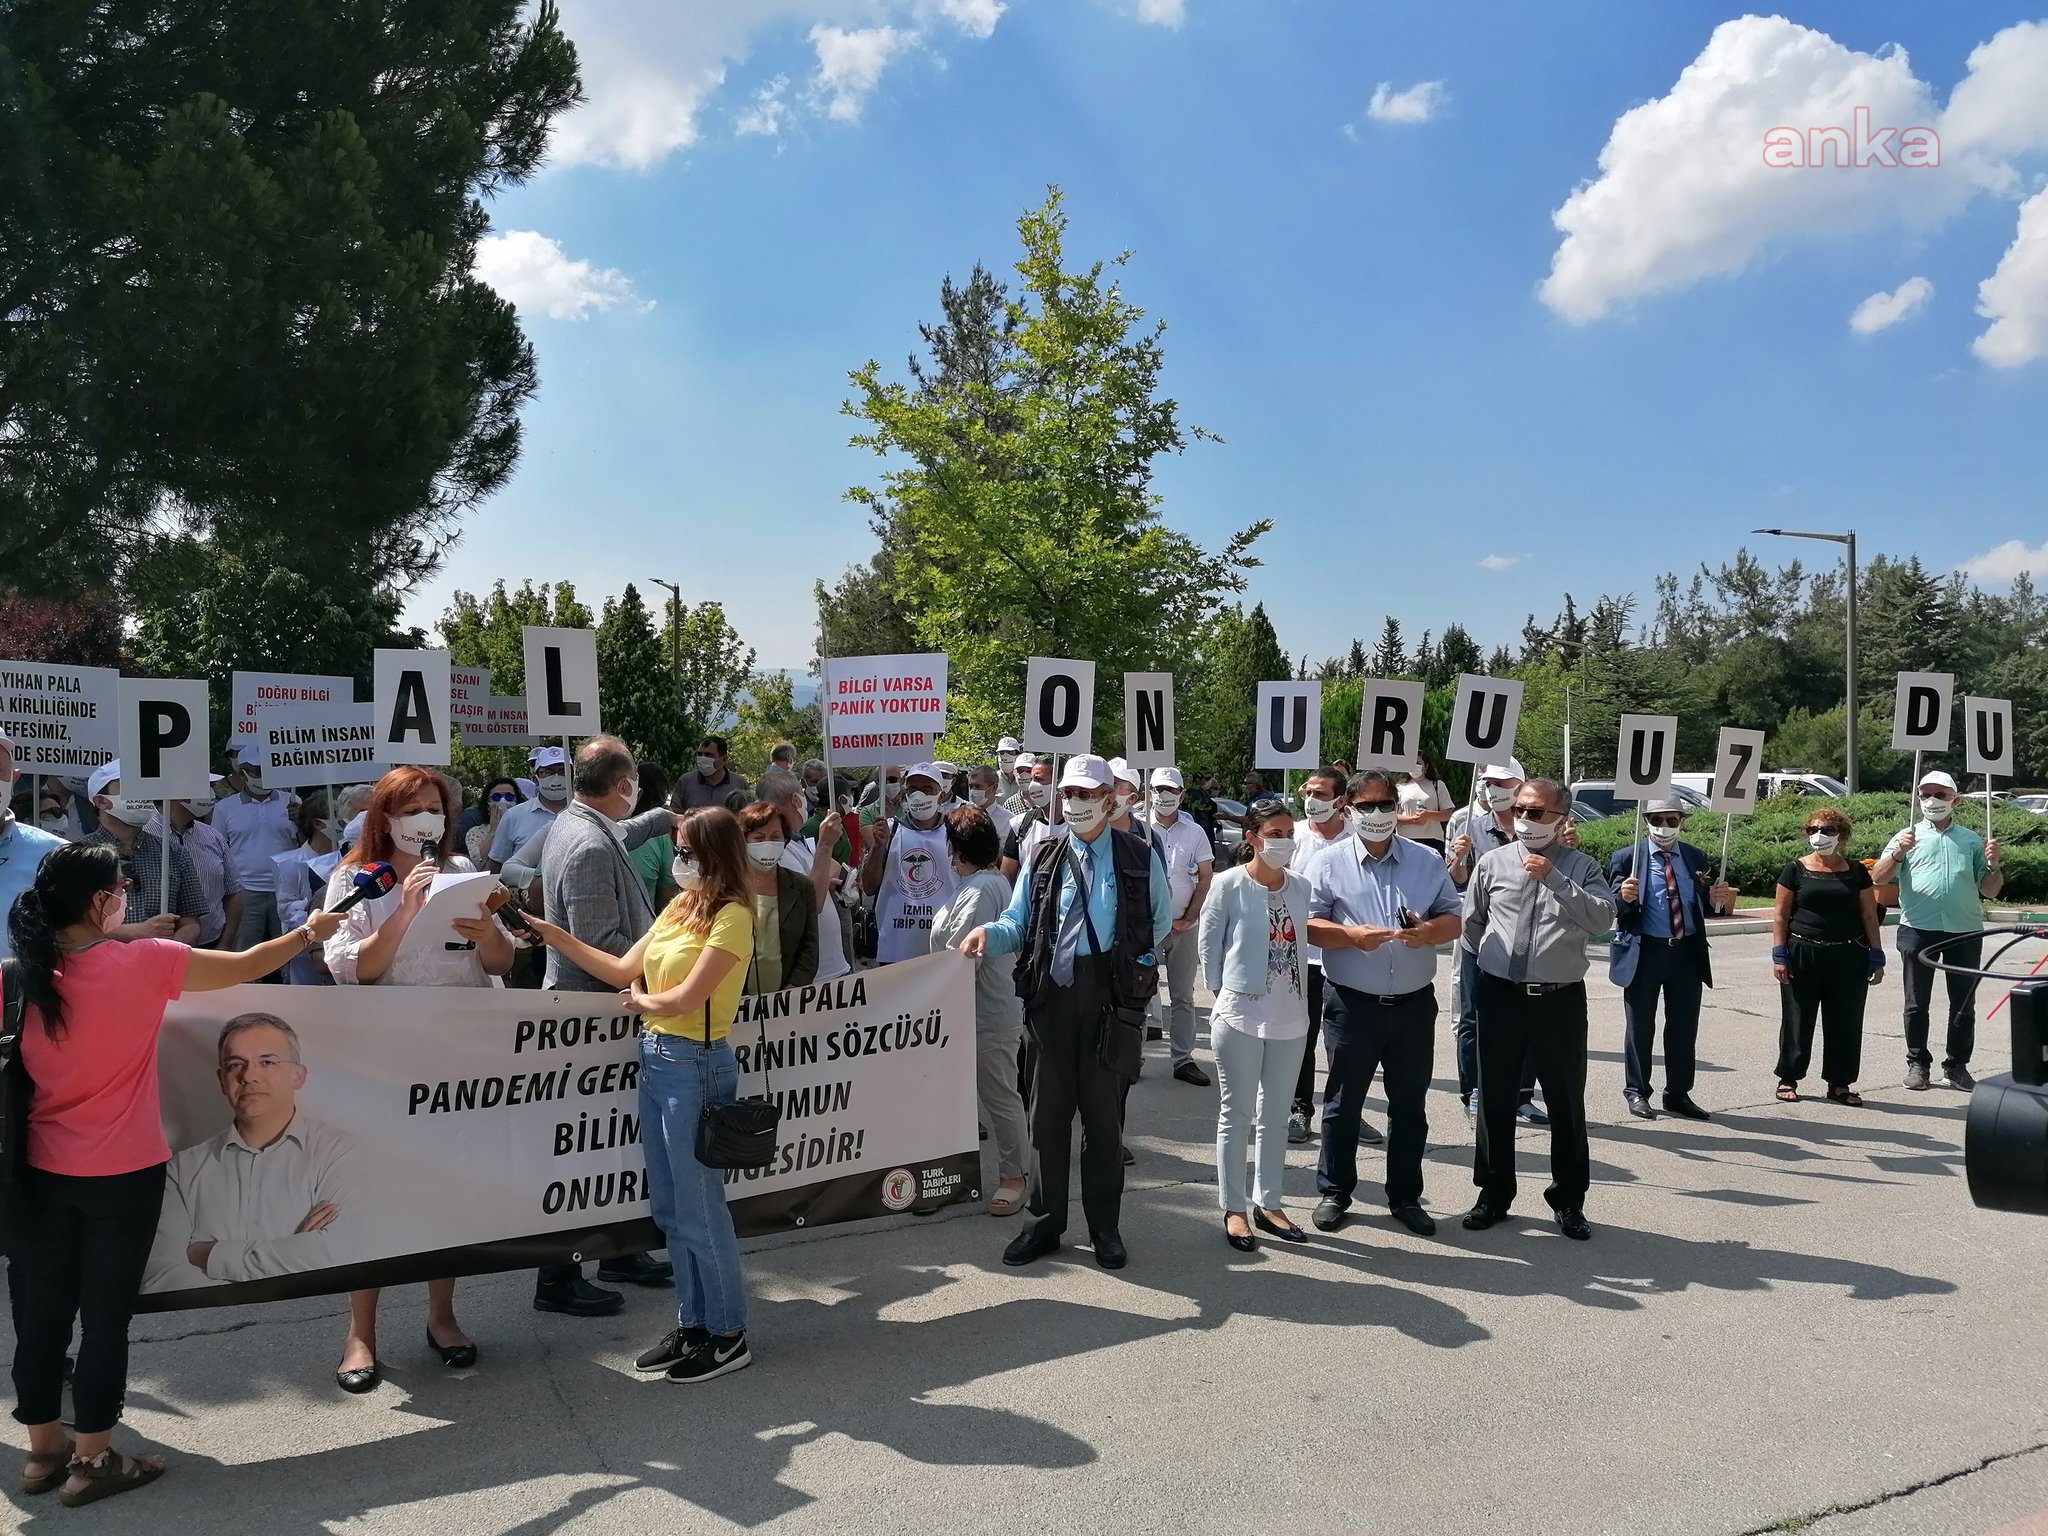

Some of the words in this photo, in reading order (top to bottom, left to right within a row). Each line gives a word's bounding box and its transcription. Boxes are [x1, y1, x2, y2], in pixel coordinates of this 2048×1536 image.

[0, 672, 42, 690] YIHAN
[48, 675, 81, 693] PALA
[10, 694, 97, 718] KİRLİLİĞİNDE
[258, 685, 296, 699] DOĞRU
[301, 686, 330, 701] BİLGİ
[388, 671, 436, 744] A
[544, 646, 581, 716] L
[830, 697, 875, 715] PANİK
[879, 698, 940, 713] YOKTUR
[838, 675, 877, 695] BİLGİ
[882, 676, 933, 692] VARSA
[1039, 674, 1080, 738] O
[269, 727, 316, 745] BİLİM
[465, 723, 484, 733] YOL
[1136, 690, 1165, 752] N
[1270, 696, 1307, 753] U
[1370, 696, 1409, 756] R
[1465, 690, 1508, 749] U
[1906, 686, 1941, 736] D
[1977, 710, 2003, 761] U
[139, 700, 191, 778] P
[1630, 730, 1665, 786] U
[1724, 743, 1752, 800] Z
[903, 902, 933, 915] İZMİR
[799, 977, 867, 1015] PALA
[408, 1062, 573, 1116] PANDEMİ
[826, 1008, 949, 1061] SÖZCÜSÜ,
